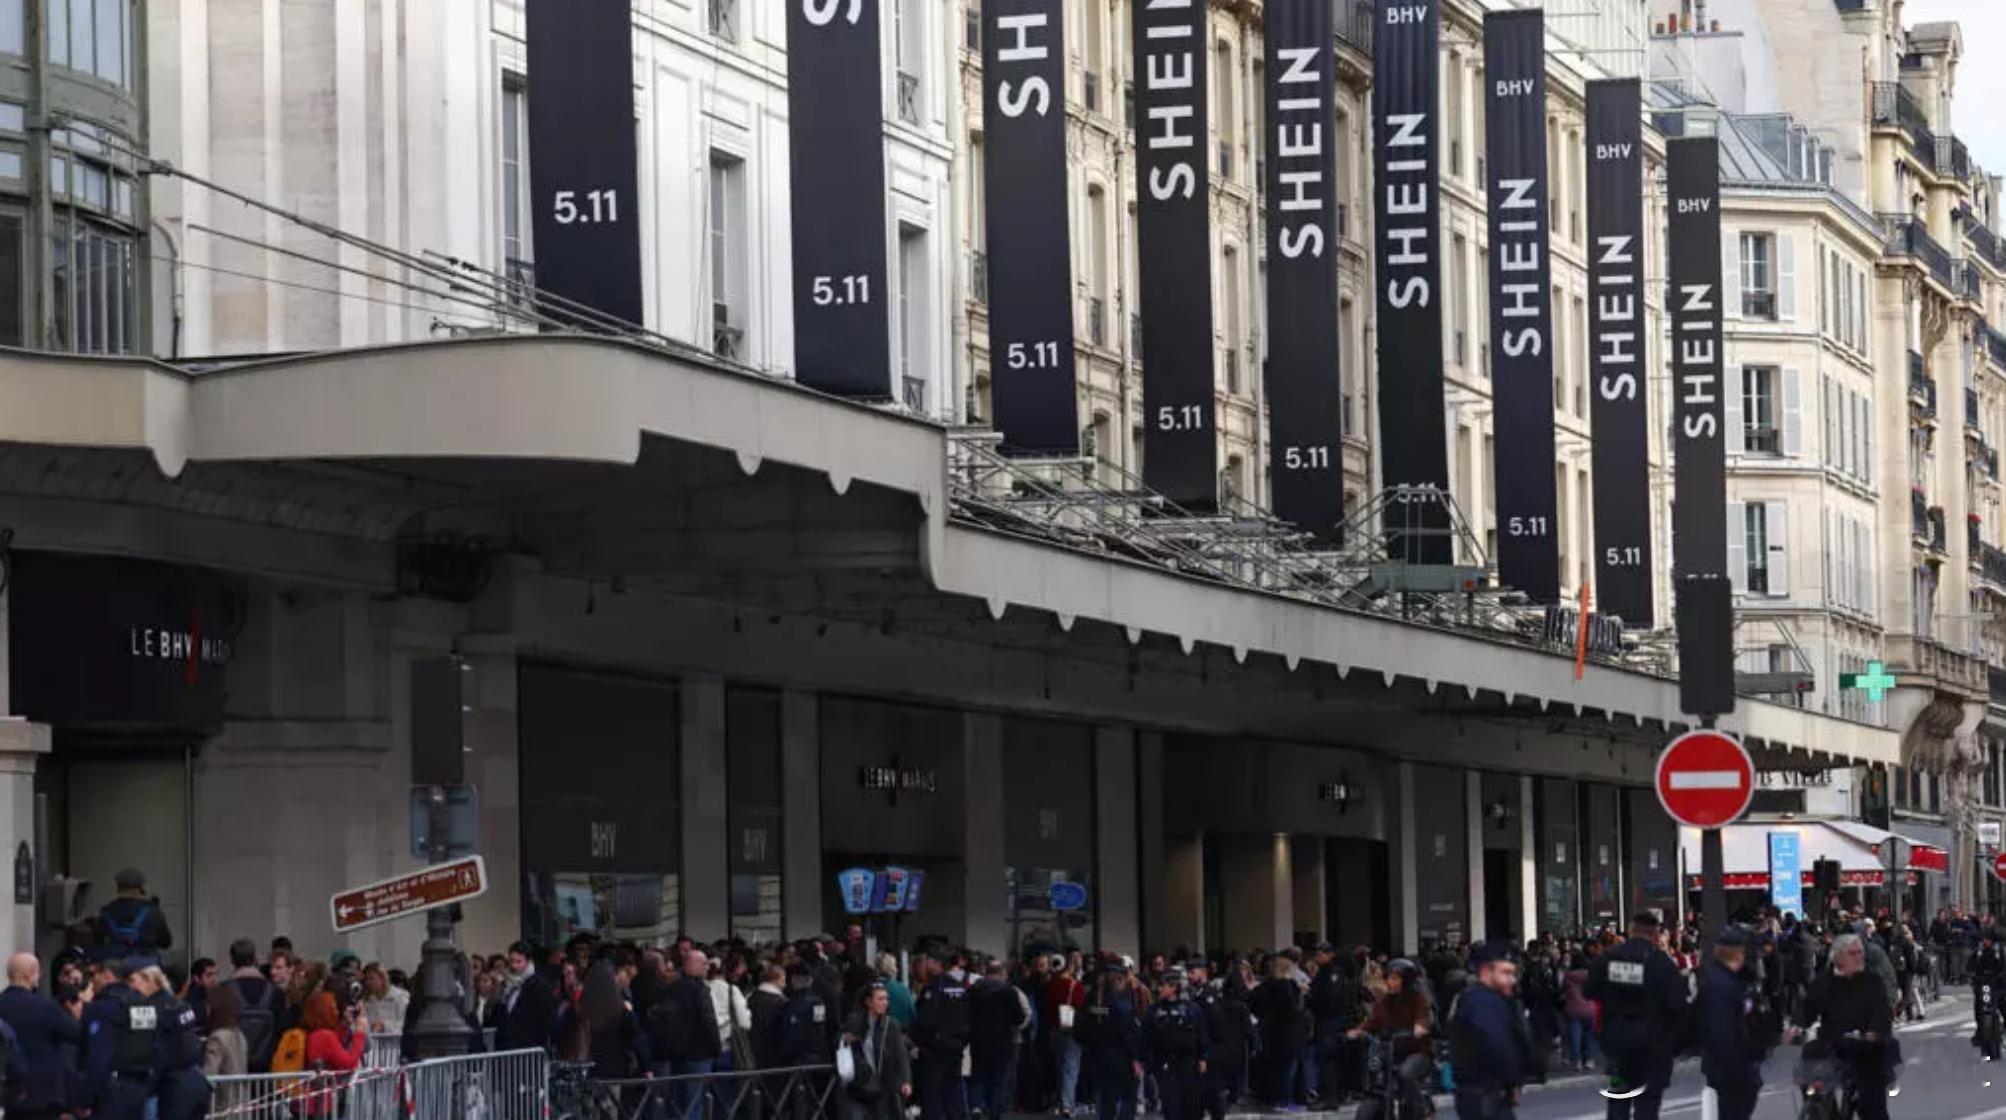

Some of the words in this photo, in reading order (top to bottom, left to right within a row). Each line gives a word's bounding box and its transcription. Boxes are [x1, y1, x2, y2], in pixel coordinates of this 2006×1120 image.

[1386, 5, 1428, 25] BHV
[1146, 0, 1196, 201] SHEI
[1496, 78, 1534, 97] BHV
[1276, 46, 1324, 261] SHEIN
[1596, 143, 1632, 160] BHV
[554, 190, 618, 224] 5.11
[1386, 113, 1430, 309] SHEIN
[1677, 197, 1711, 213] BHV
[1498, 178, 1542, 357] SHEIN
[812, 275, 870, 305] 5.11
[1597, 235, 1637, 400] SHEIN
[1007, 341, 1058, 369] 5.11
[1680, 283, 1717, 438] SHEIN
[1158, 405, 1202, 430] 5.11
[1285, 446, 1329, 470] 5.11
[1509, 516, 1547, 536] 5.11
[1606, 546, 1641, 566] 5.11
[131, 628, 154, 657] LE
[160, 631, 193, 660] BHV
[591, 821, 617, 858] BHV
